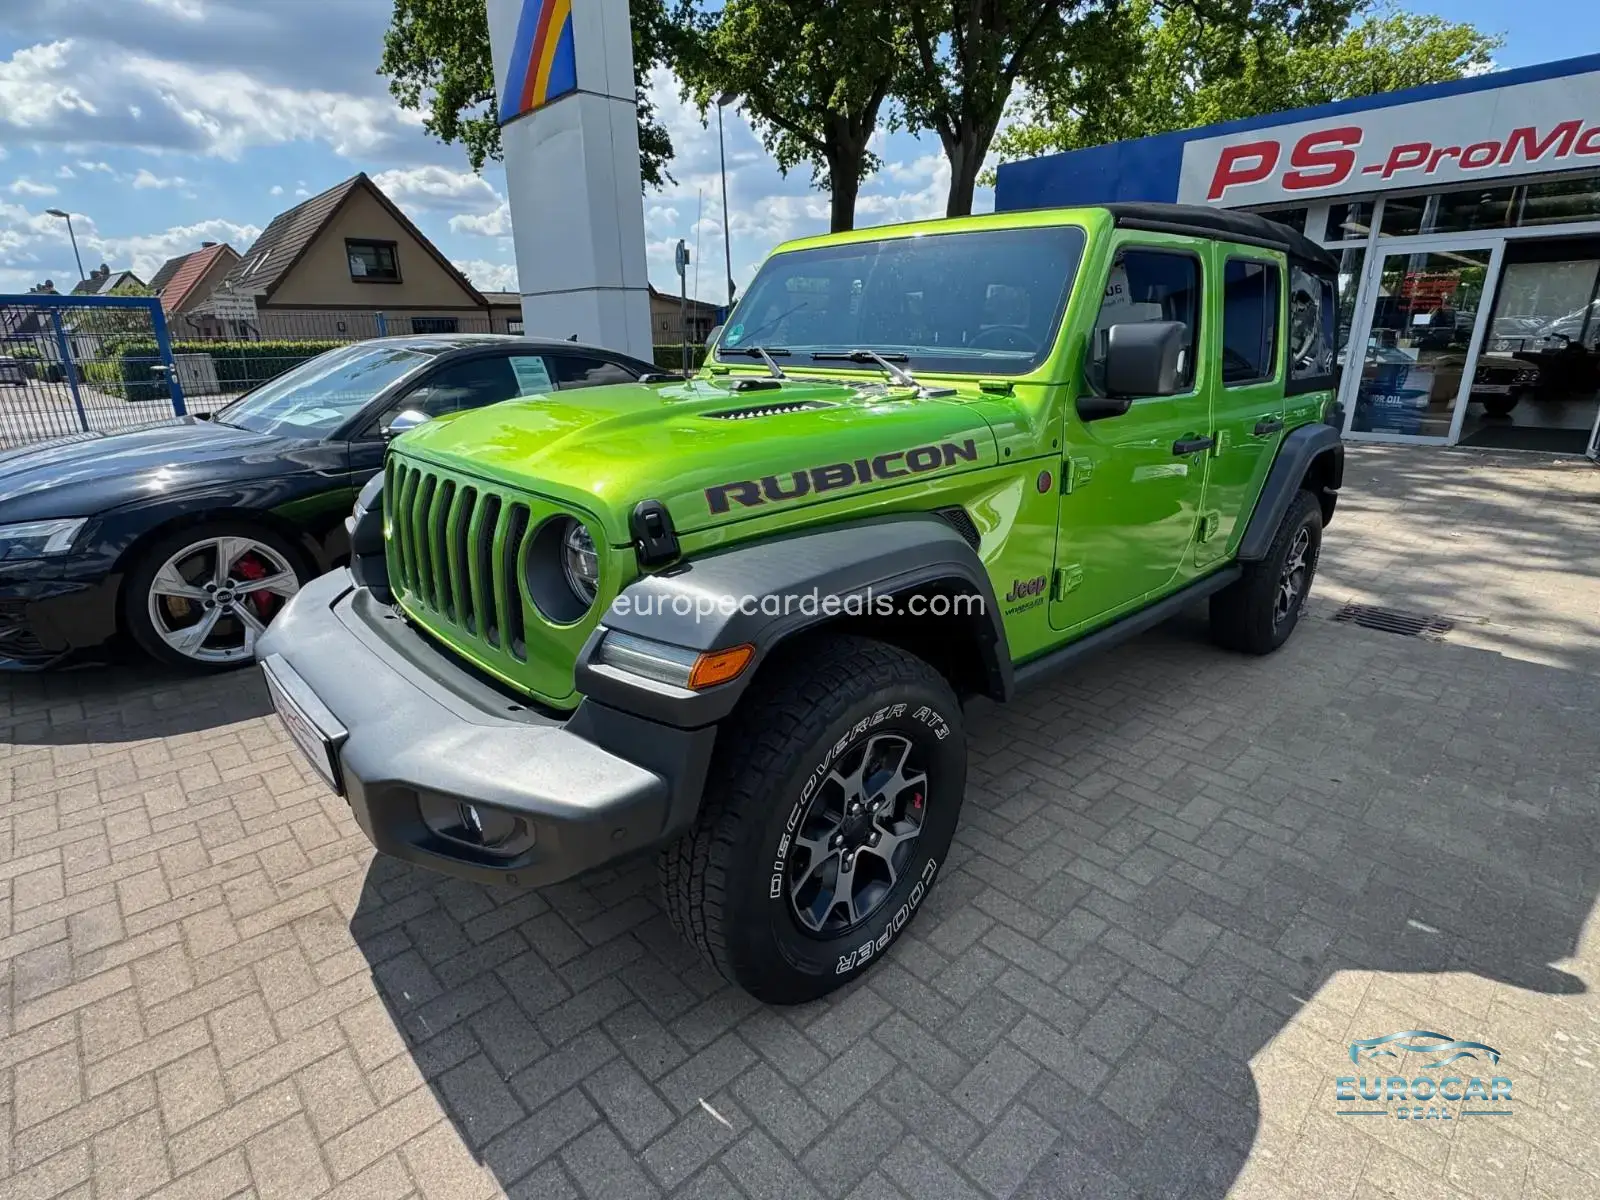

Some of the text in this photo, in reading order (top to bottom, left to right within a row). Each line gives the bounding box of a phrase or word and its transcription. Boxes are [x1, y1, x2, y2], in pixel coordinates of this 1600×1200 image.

[705, 438, 977, 515] RUBICON
[1006, 575, 1047, 602] Jeep
[770, 703, 949, 898] DISCOVERER AT3
[836, 858, 937, 974] COOPER
